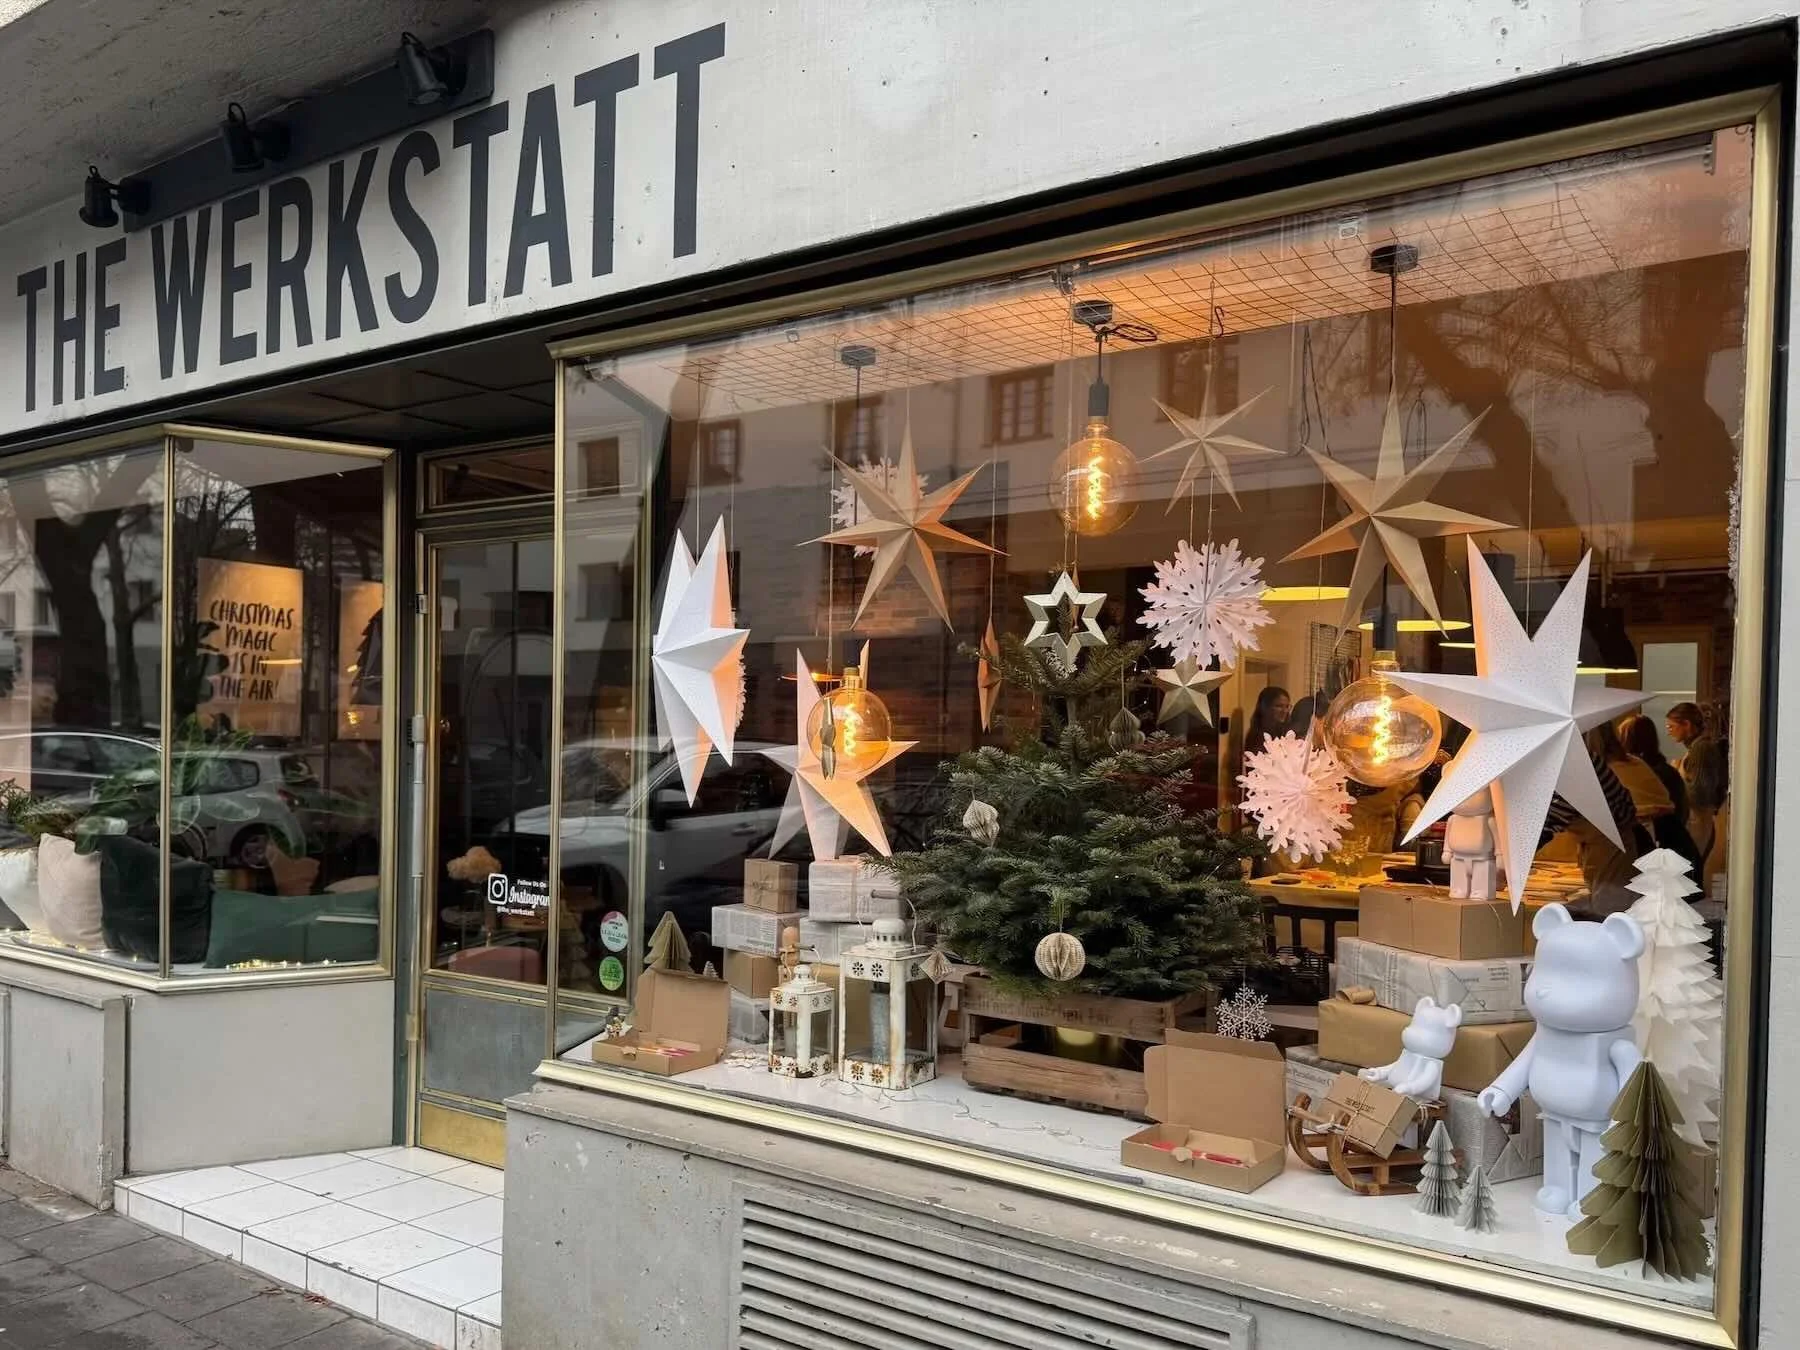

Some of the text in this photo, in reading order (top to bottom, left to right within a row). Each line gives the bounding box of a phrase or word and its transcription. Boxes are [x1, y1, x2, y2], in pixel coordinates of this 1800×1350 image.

[17, 22, 725, 412] THE WERKSTATT
[210, 599, 295, 630] CHRISTMAS
[225, 623, 279, 652] MAGIC
[233, 652, 269, 676] IS IN
[219, 675, 244, 698] THE
